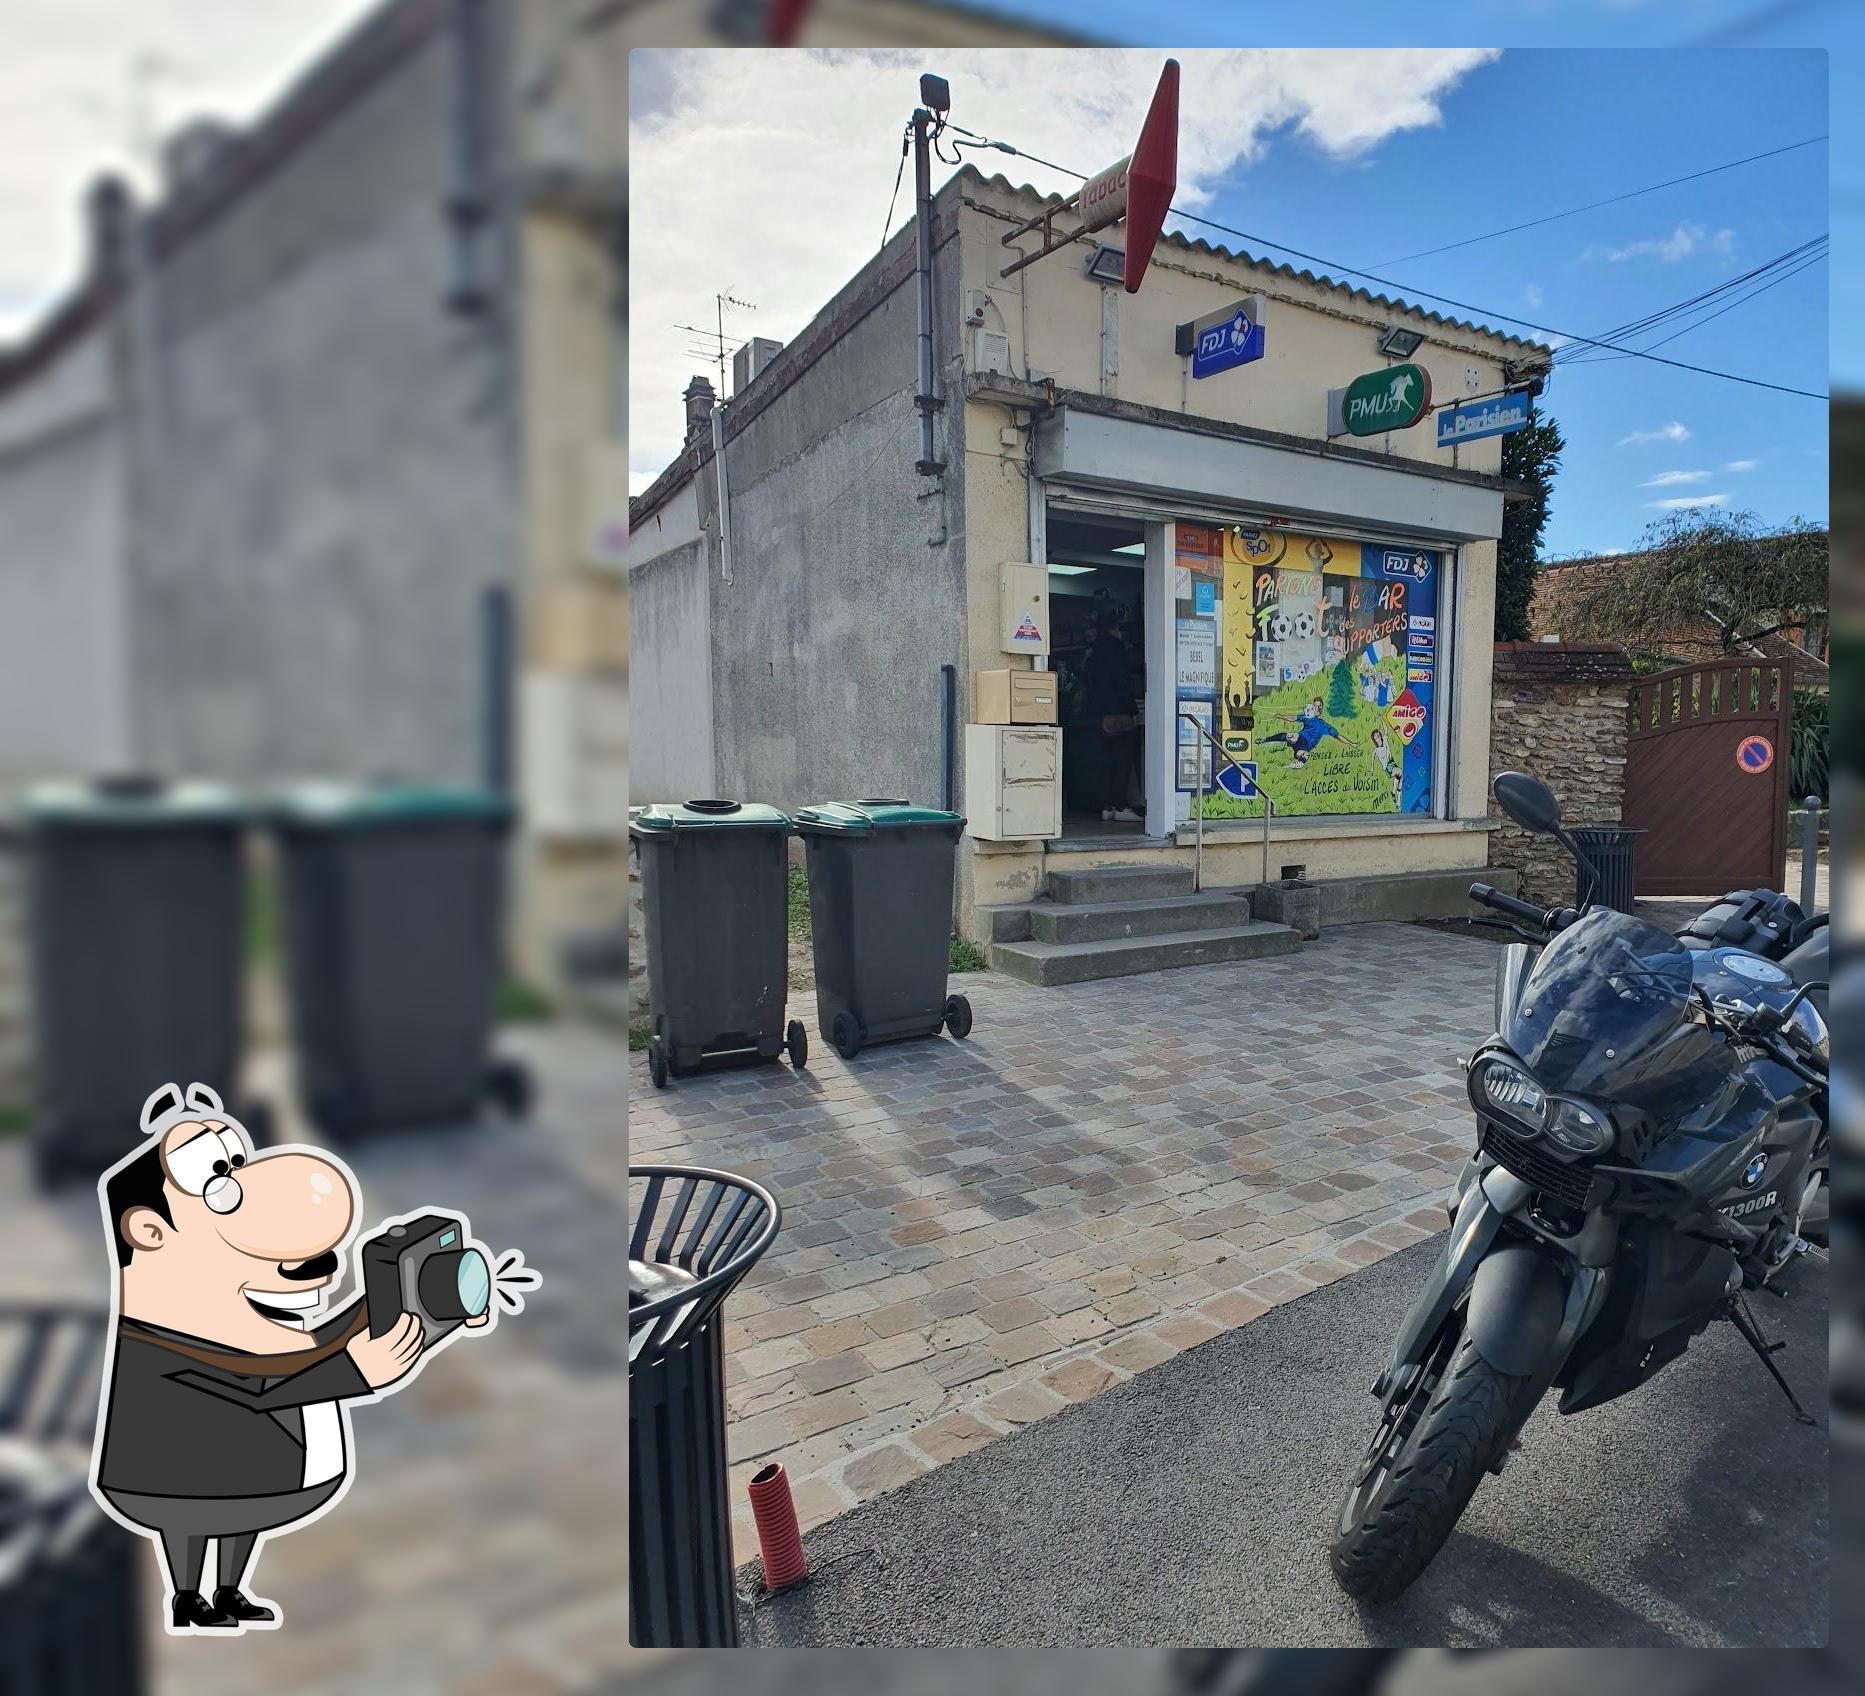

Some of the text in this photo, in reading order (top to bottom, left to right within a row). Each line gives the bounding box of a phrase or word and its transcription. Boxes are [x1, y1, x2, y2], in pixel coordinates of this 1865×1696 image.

[1201, 329, 1226, 354] FDJ
[1350, 394, 1389, 420] PMU
[1455, 405, 1523, 434] Parisien
[1386, 556, 1410, 571] FDJ
[1255, 573, 1322, 607] PARIONS
[1349, 582, 1405, 615] le BAR
[1333, 612, 1408, 656] SUPPORTERS
[1339, 617, 1355, 633] des
